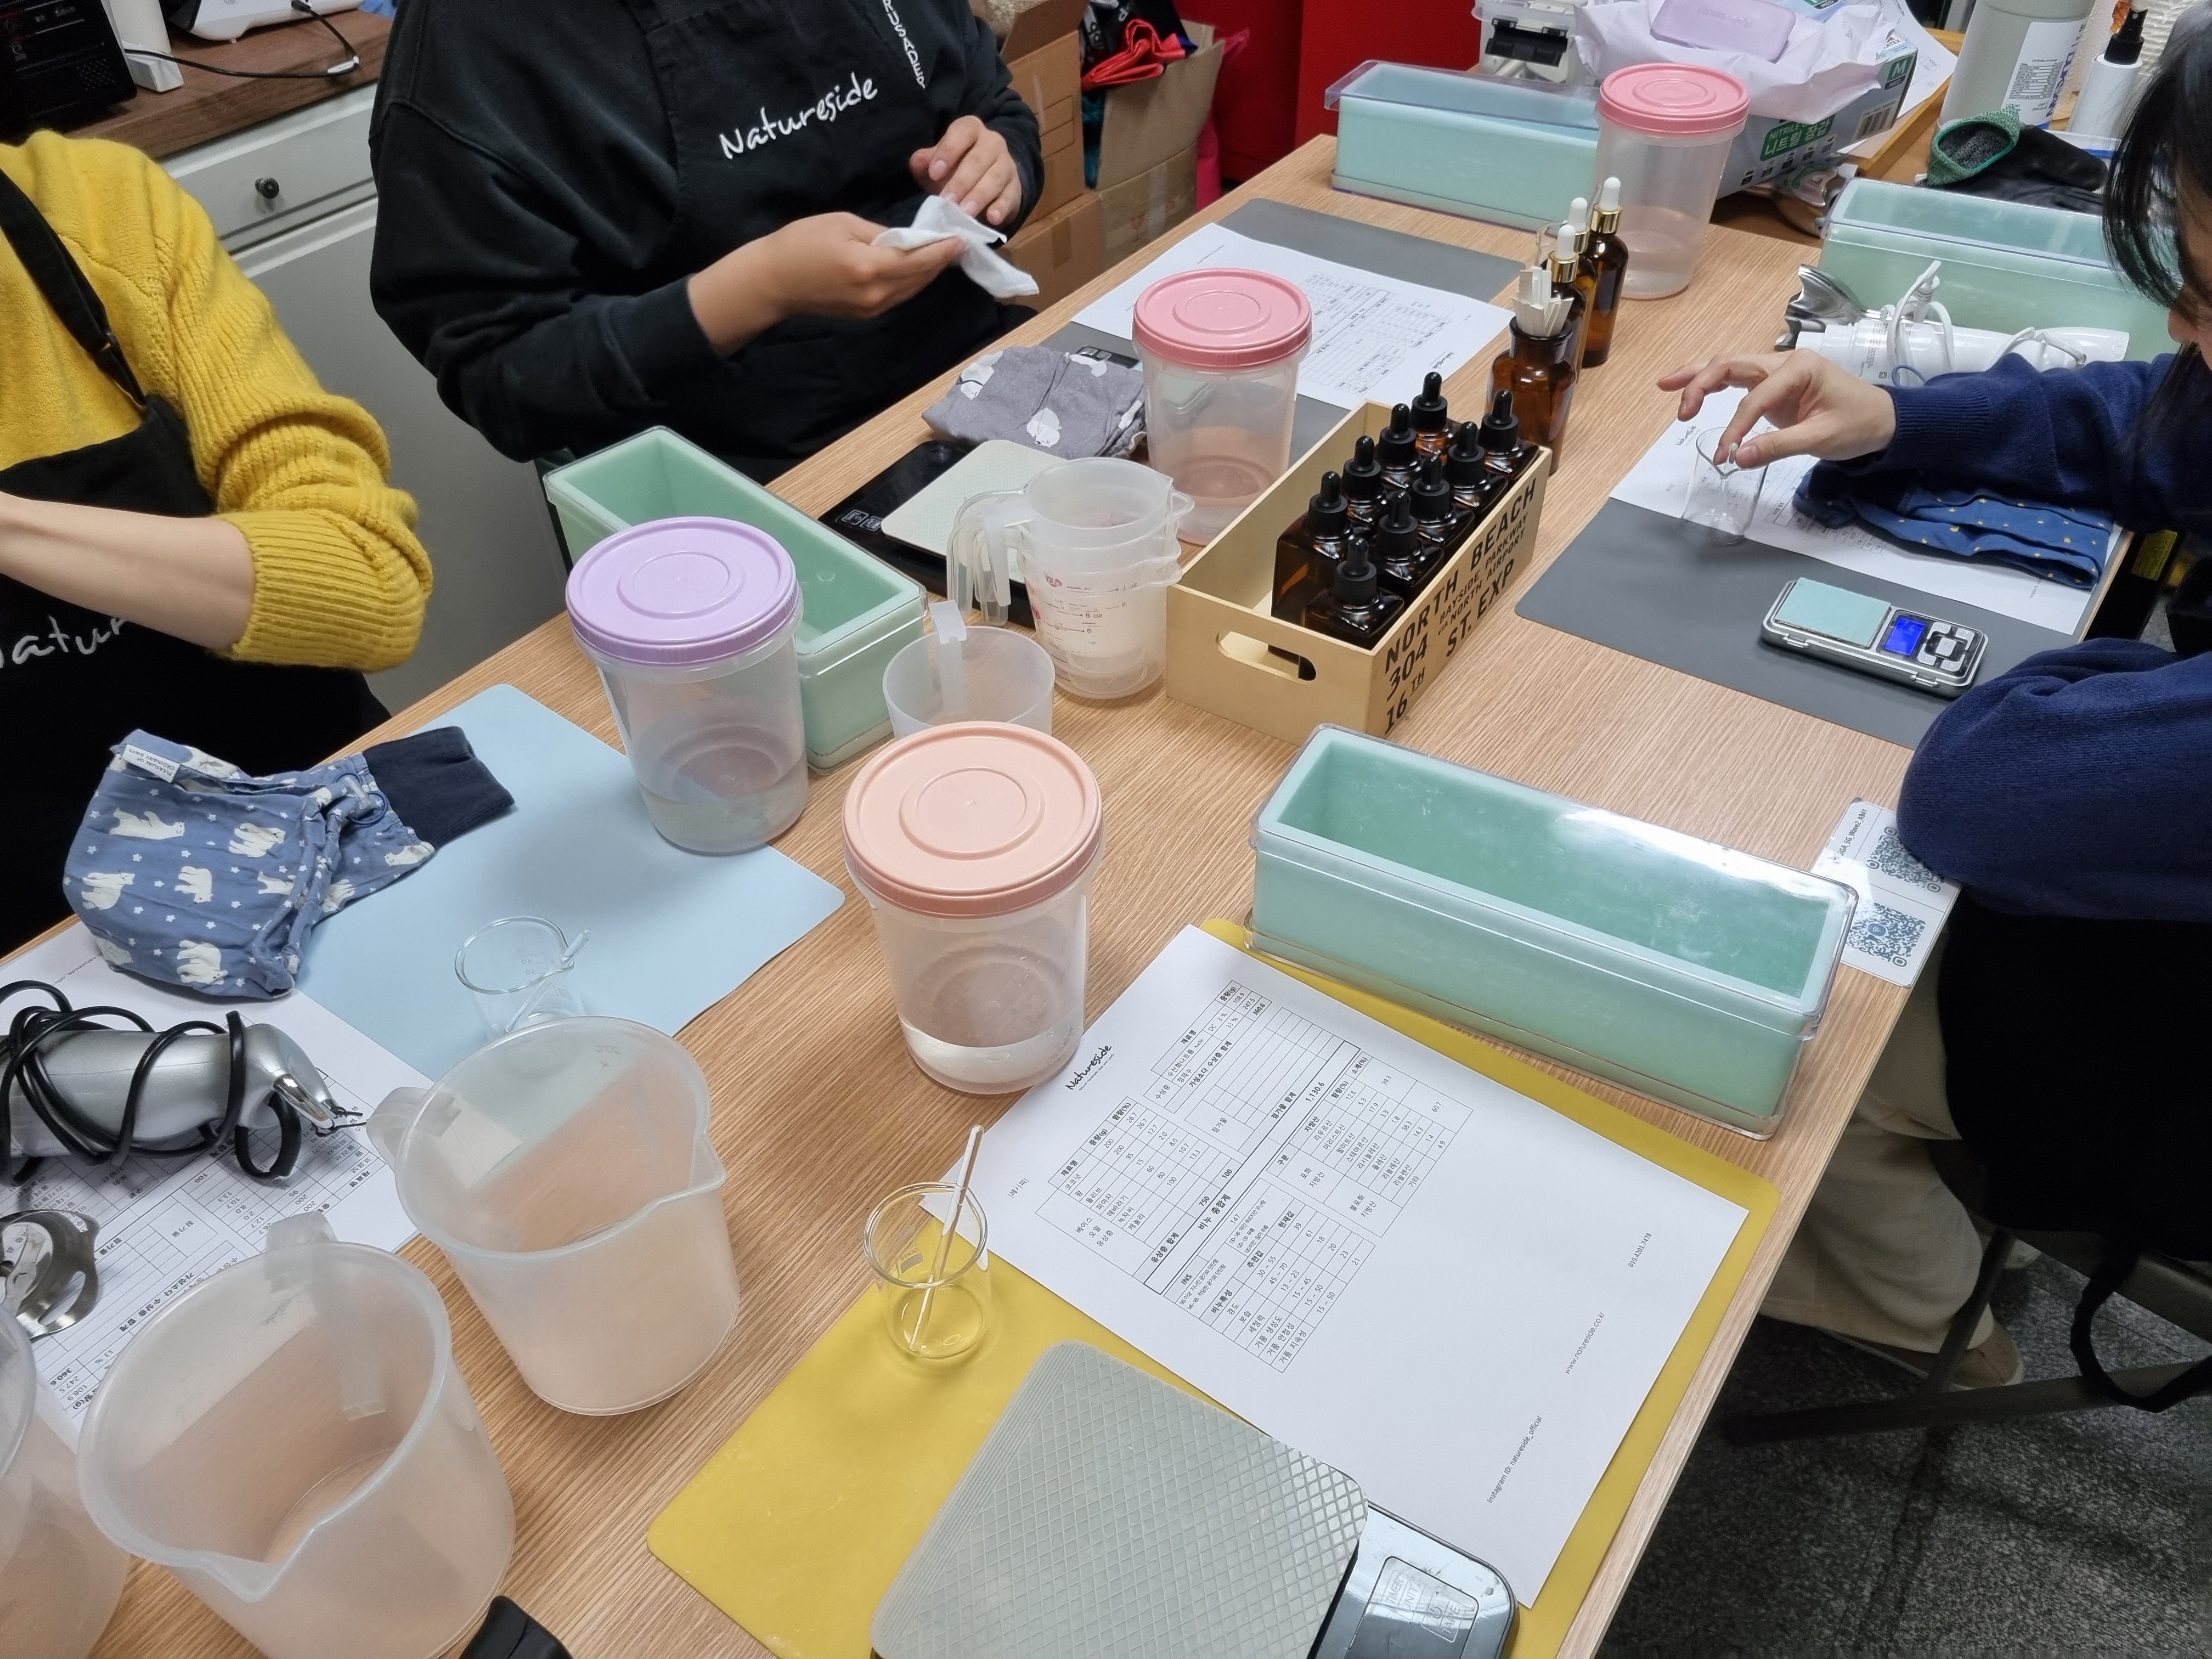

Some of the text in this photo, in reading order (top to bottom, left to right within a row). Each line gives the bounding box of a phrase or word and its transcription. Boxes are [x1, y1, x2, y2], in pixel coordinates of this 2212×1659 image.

[1892, 60, 1908, 78] M
[719, 71, 878, 160] Natureside
[1764, 117, 1830, 156] 니트릴 장갑
[1385, 477, 1537, 674] NORTH BEACH
[1440, 511, 1529, 624] BAYSIDE PARKWAY
[1449, 579, 1482, 629] NORTH
[1486, 529, 1525, 583] AIRPORT
[1446, 558, 1515, 658] ST. EXP
[0, 615, 129, 669] atur
[1386, 635, 1427, 701] 304
[145, 756, 174, 770] ORDINARY
[146, 761, 172, 776] PLEASURE
[52, 955, 97, 986] natureside_offici
[1181, 986, 1237, 1044] 재료명 중량(g)
[1168, 993, 1244, 1076] 수산화나트륨 108.9
[1177, 998, 1255, 1082] 정제수 247.5
[1189, 1003, 1265, 1087] 가성소다 수상층 합계 360.6
[1065, 1046, 1111, 1090] Natureside
[1156, 1085, 1170, 1098] 수상층
[1271, 1092, 1296, 1119] 첨가물 합계
[1277, 1057, 1368, 1165] 구분 지방산 함량(%) 소계(%)
[1313, 1075, 1391, 1140] 라우르산 12.8 39.3
[1061, 1103, 1131, 1176] 재료명 중량(g) 함량(%)
[1114, 1119, 1147, 1155] 200 26.7
[1212, 1118, 1227, 1133] 첨가물
[1323, 1124, 1346, 1149] 미리스트산
[1336, 1103, 1378, 1154] 팔미트산 17.9
[1372, 1102, 1441, 1170] 올레산 38.3 60.7
[325, 1140, 347, 1157] 피마자
[1065, 1113, 1137, 1190] 코코넛 200 26.7
[1198, 1082, 1324, 1229] 비누 총합계 1,130.6
[1347, 1137, 1368, 1163] 스테아르산
[1357, 1143, 1379, 1169] 리시놀레산
[1381, 1127, 1423, 1179] 리놀레산 14.3
[195, 1174, 207, 1183] 100
[349, 1171, 370, 1187] 재료명
[1086, 1188, 1102, 1203] 올리브
[1148, 1125, 1158, 1135] 12.7
[1300, 1167, 1312, 1179] 포화
[1393, 1165, 1412, 1186] 리놀렌산
[303, 1157, 370, 1214] 코코넛 200
[1118, 1143, 1189, 1222] 녹차씨 10.7
[1128, 1150, 1200, 1230] 캐놀라 100 13.3
[1309, 1172, 1324, 1187] 지방산
[1408, 1176, 1420, 1187] 기타
[218, 1192, 232, 1202] 13.3
[227, 1198, 240, 1209] 10.7
[295, 1194, 308, 1205] 200
[1096, 1194, 1113, 1210] 피마자
[1107, 1195, 1128, 1216] 해바라기
[1350, 1194, 1365, 1211] 불포화
[1361, 1201, 1376, 1217] 지방산
[172, 1221, 194, 1237] 첨가물
[244, 1211, 255, 1220] 2.0
[251, 1217, 264, 1228] 12.7
[1075, 1218, 1092, 1233] 베이스
[1152, 1169, 1232, 1263] 유상층 합계 750 100
[99, 1238, 122, 1255] 첨가물
[1089, 1226, 1101, 1238] 오일
[1097, 1230, 1113, 1246] 유상층
[1181, 1214, 1240, 1285] INS 147
[1211, 1211, 1295, 1313] 비누특성 추천값 현재값
[1628, 1233, 1651, 1267] 010.4201.7478
[120, 1273, 194, 1332] 가성소다 수상층 합계
[1227, 1303, 1239, 1314] 경도
[1255, 1335, 1267, 1348] 거품
[1266, 1316, 1282, 1333] 생성도
[1328, 1243, 1336, 1251] 20
[1239, 1311, 1251, 1323] 보습
[1249, 1315, 1265, 1333] 세정력
[104, 1349, 114, 1357] 33
[1267, 1343, 1279, 1356] 거품
[1278, 1323, 1294, 1341] 안정성
[1279, 1351, 1291, 1363] 거품
[1290, 1330, 1307, 1348] 지속성
[1565, 1312, 1604, 1374] www.natureside.co.kr
[50, 1368, 72, 1386] 360.6
[59, 1376, 80, 1393] 247.5
[67, 1385, 87, 1401] 108.9
[1487, 1415, 1542, 1503] Instagram ID: natureside_official
[1387, 1575, 1404, 1604] TIMER
[1403, 1582, 1420, 1612] UNIT
[1441, 1603, 1462, 1636] TARE
